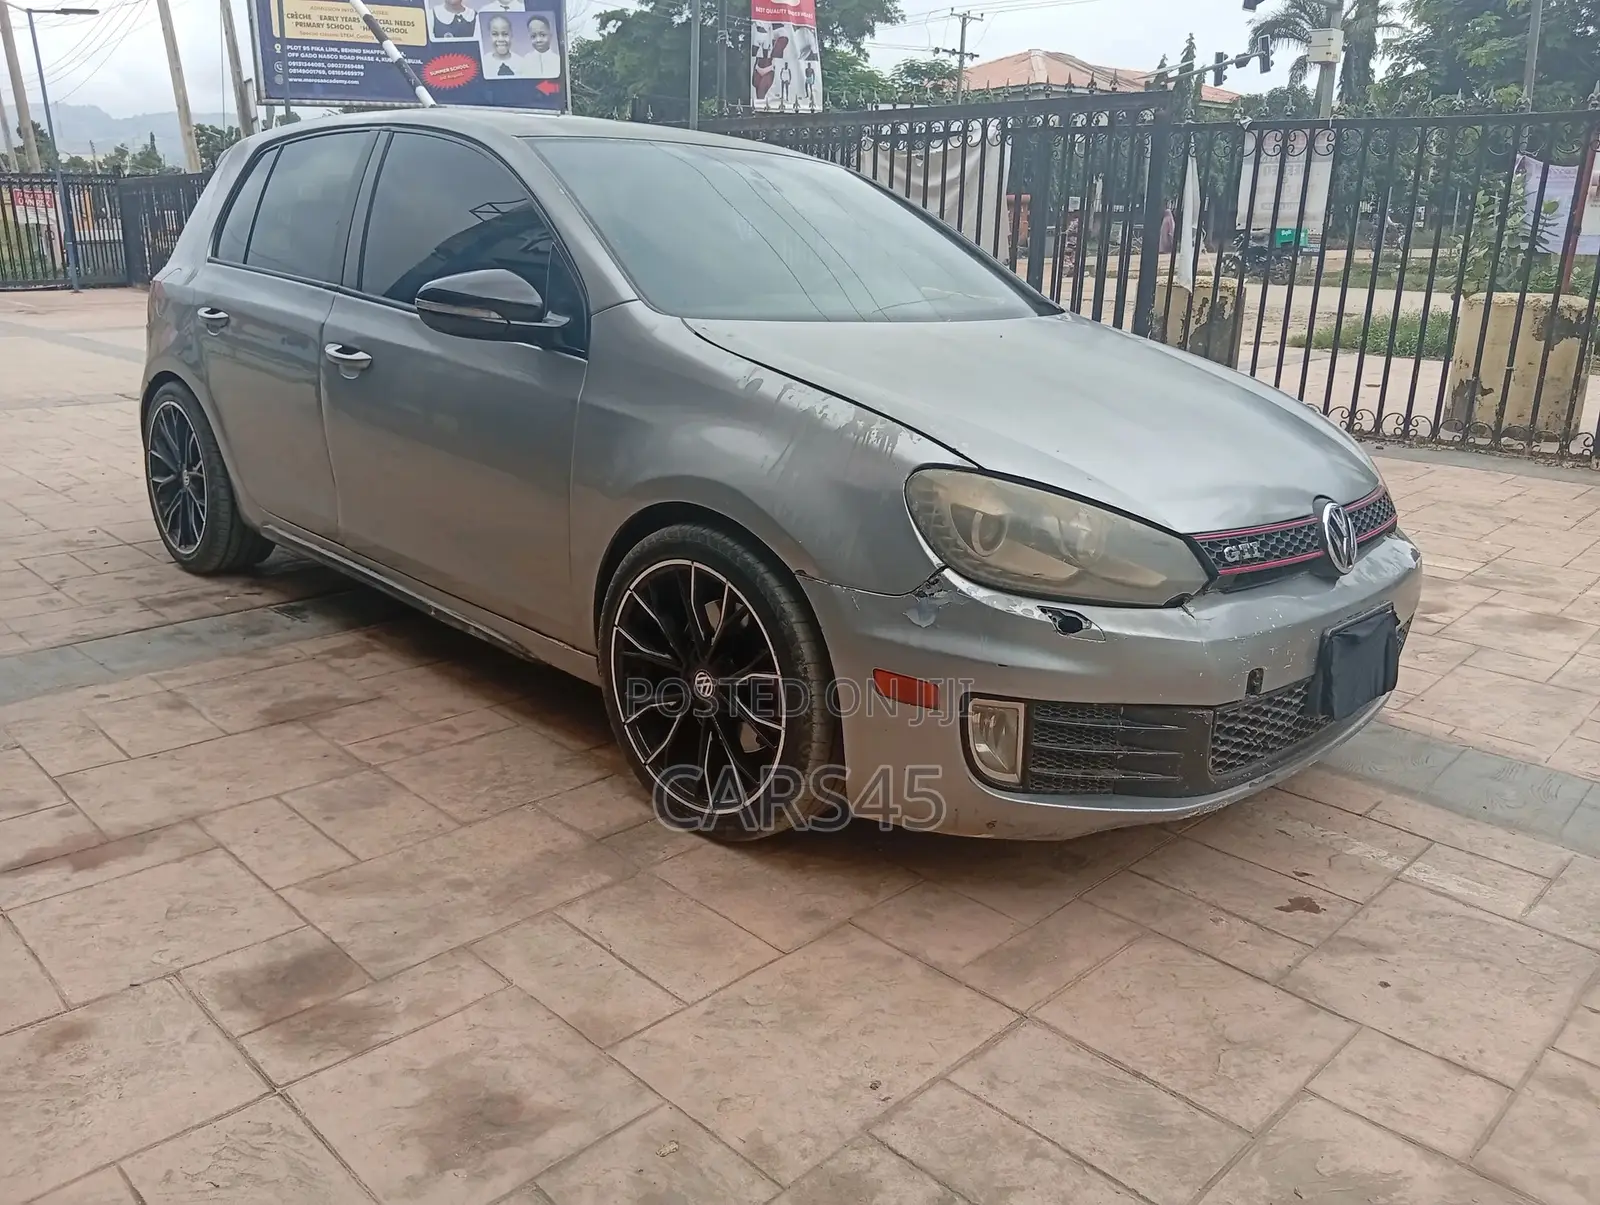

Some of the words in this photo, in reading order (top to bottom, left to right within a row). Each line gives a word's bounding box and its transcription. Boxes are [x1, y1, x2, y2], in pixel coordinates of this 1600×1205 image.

[319, 14, 339, 22] EARLY
[341, 15, 361, 23] YEARS
[295, 21, 325, 29] PRIMARY
[429, 67, 450, 76] SUMMER
[449, 63, 470, 72] SCHOOL
[1223, 540, 1261, 562] GTI
